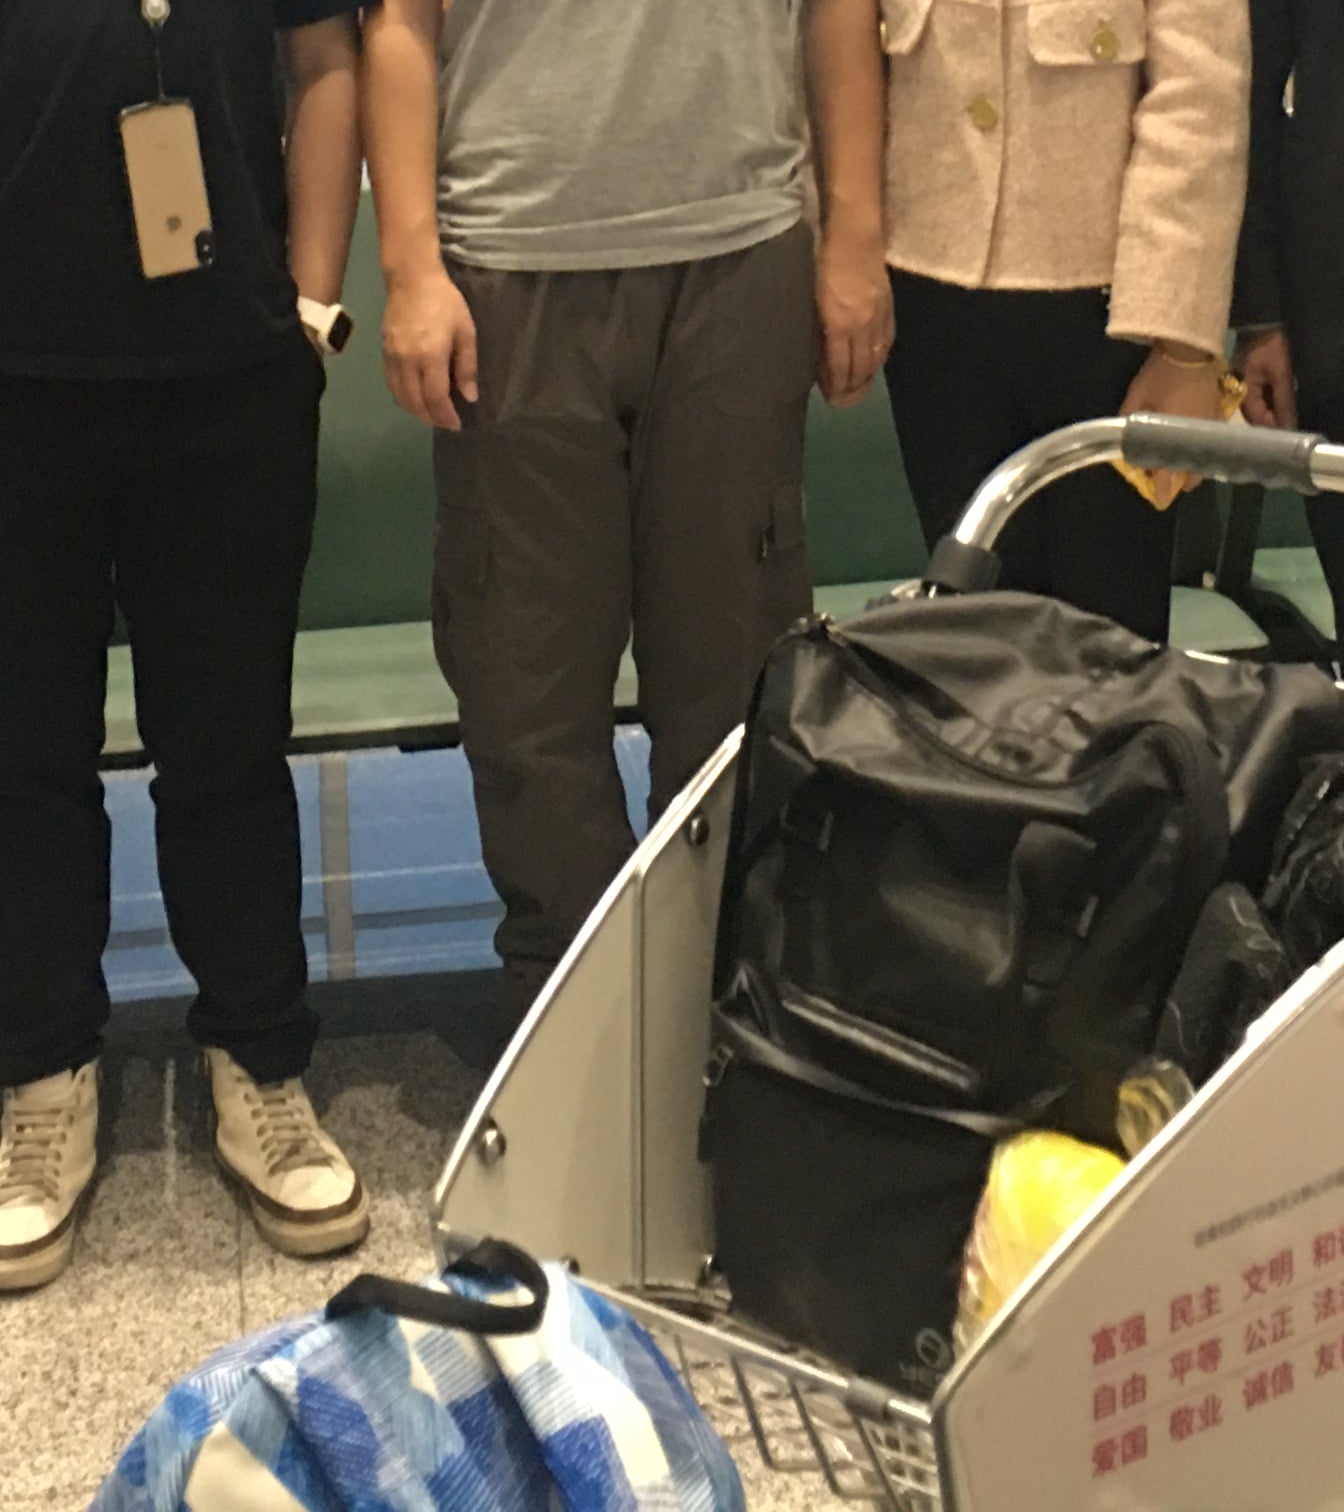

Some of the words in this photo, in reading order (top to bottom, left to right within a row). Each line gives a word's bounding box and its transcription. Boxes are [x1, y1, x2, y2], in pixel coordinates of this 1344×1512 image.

[1090, 1314, 1147, 1366] 富强
[1169, 1284, 1222, 1332] 民主
[1241, 1248, 1294, 1303] 文明
[1092, 1372, 1147, 1422] 自由
[1169, 1336, 1222, 1385] 平等
[1244, 1304, 1294, 1354] 公正
[1091, 1424, 1147, 1480] 爱国
[1168, 1392, 1222, 1442] 敬业
[1242, 1360, 1294, 1411] 诚信
